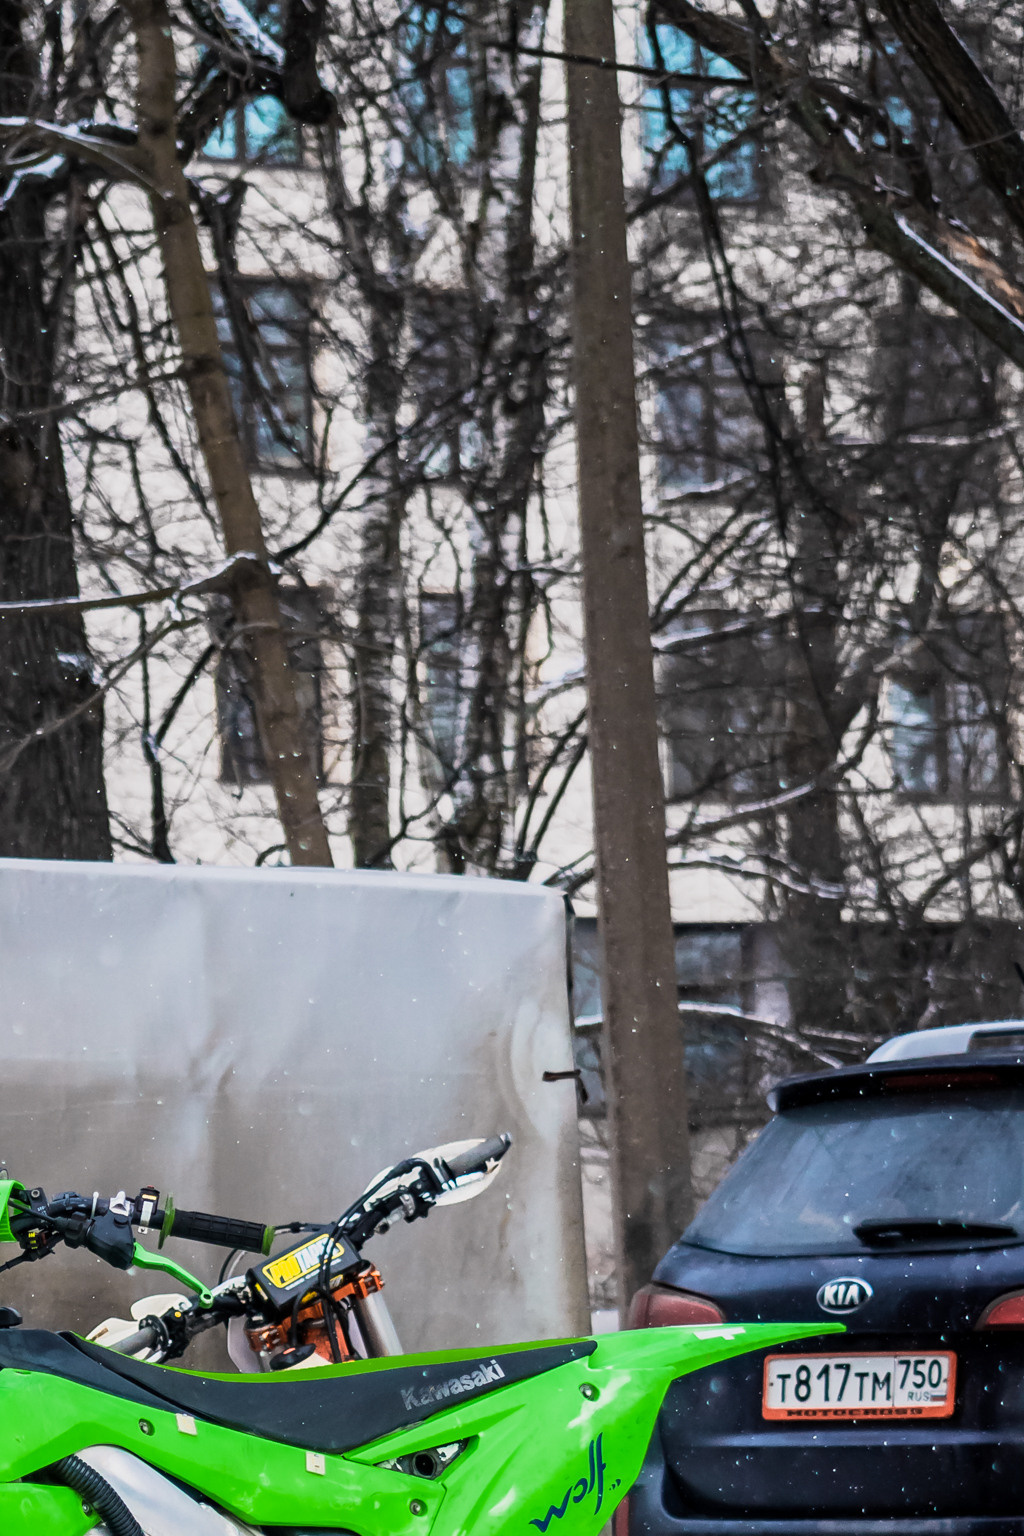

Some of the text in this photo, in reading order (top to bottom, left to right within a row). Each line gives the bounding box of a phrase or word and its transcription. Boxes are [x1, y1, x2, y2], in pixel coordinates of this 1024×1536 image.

[824, 1284, 859, 1305] KIA
[400, 1359, 505, 1410] Kawasaki
[897, 1359, 942, 1389] 750
[907, 1391, 930, 1401] RUS
[787, 1408, 923, 1417] MOTOCROSS
[528, 1432, 606, 1532] wolf
